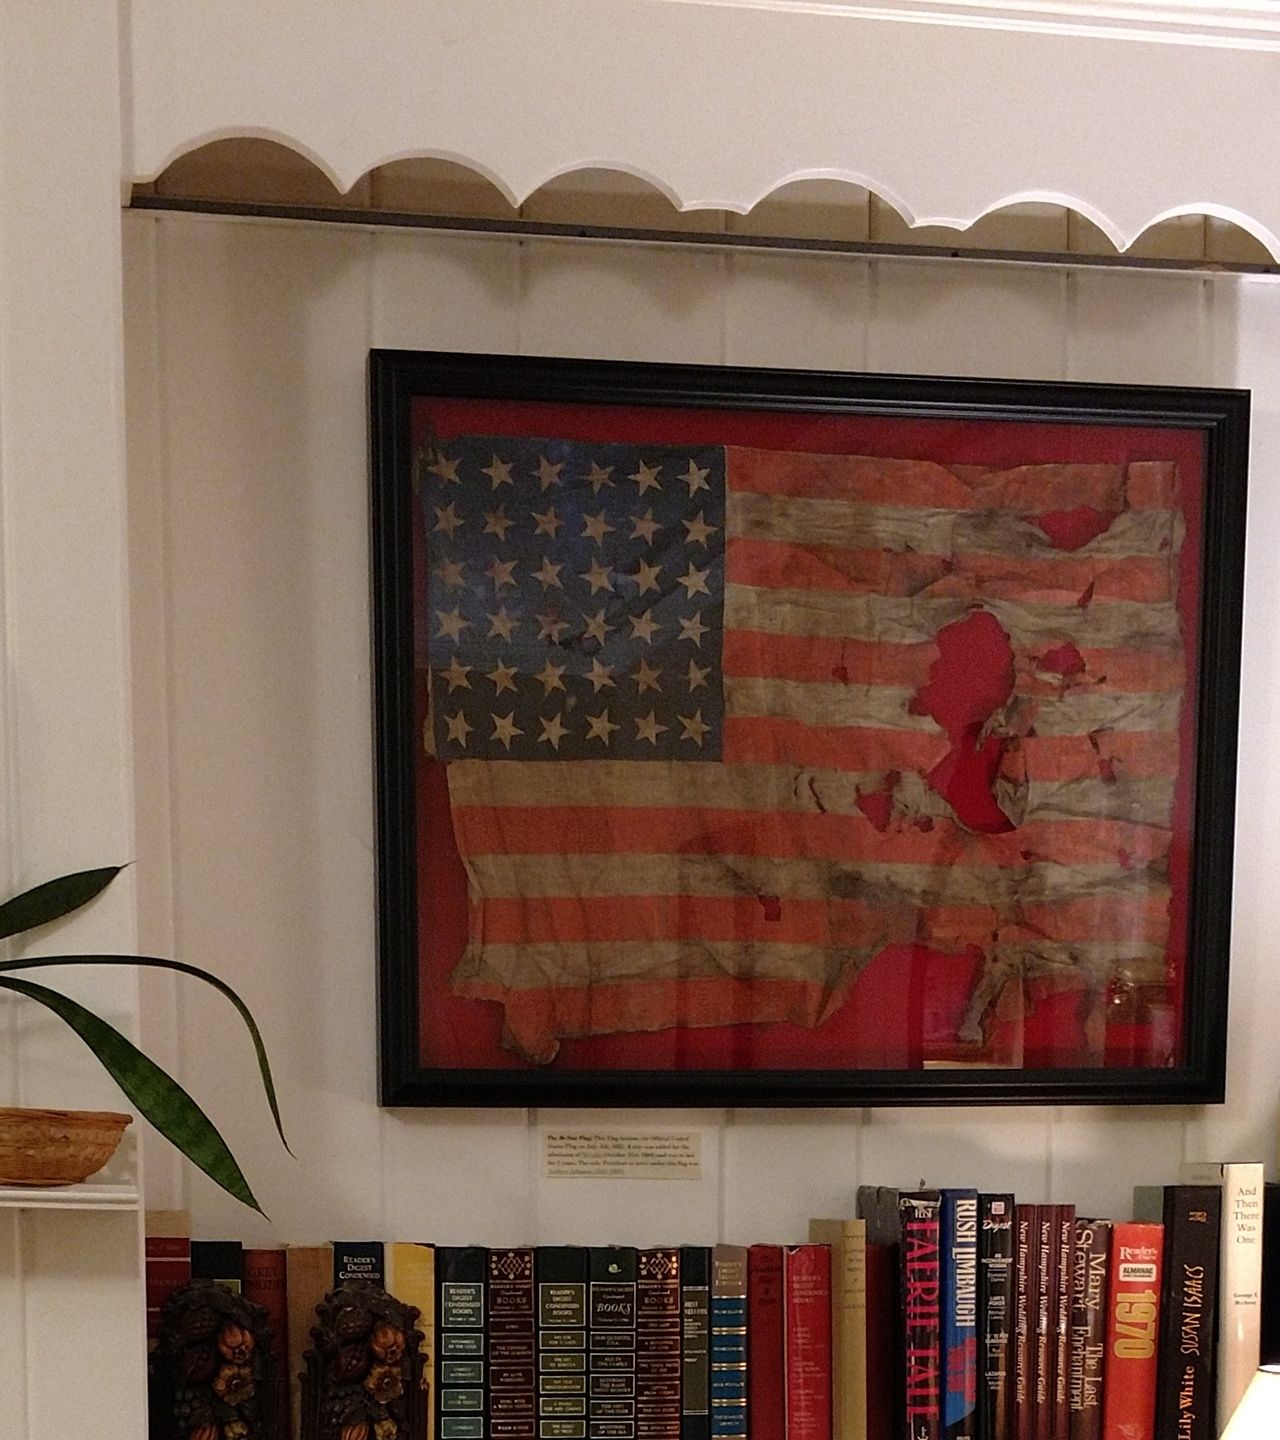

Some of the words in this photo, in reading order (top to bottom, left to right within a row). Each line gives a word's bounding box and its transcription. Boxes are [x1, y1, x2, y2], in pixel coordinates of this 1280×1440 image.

[1236, 1199, 1258, 1208] Then
[1238, 1187, 1257, 1196] And
[955, 1199, 977, 1243] RUSH
[982, 1218, 1012, 1233] Digest
[1019, 1221, 1029, 1243] New
[1040, 1221, 1050, 1243] New
[1061, 1221, 1070, 1243] New
[1234, 1211, 1260, 1220] There
[1236, 1236, 1256, 1244] One
[347, 1263, 373, 1271] DIGEST
[906, 1220, 940, 1332] FAERIE
[1016, 1244, 1028, 1293] Hampshire
[1038, 1244, 1050, 1293] Hampshire
[1059, 1244, 1069, 1293] Hampshire
[1074, 1229, 1094, 1311] Stewart
[1086, 1252, 1106, 1310] Mary
[951, 1246, 976, 1328] LIMBAUGH
[1183, 1264, 1204, 1307] ISAACS
[596, 1303, 632, 1315] BOOKS
[1114, 1289, 1157, 1359] 1970
[1180, 1312, 1201, 1356] SUSAN
[1017, 1335, 1026, 1375] Resource
[1037, 1335, 1047, 1375] Resource
[1057, 1335, 1066, 1375] Resource
[1085, 1343, 1103, 1369] The
[906, 1342, 940, 1422] TALE
[1015, 1377, 1025, 1404] Guide
[1036, 1377, 1046, 1404] Guide
[1056, 1377, 1066, 1404] Guide
[1084, 1376, 1102, 1408] Last
[1179, 1365, 1195, 1409] White
[1177, 1410, 1196, 1440] Lily
